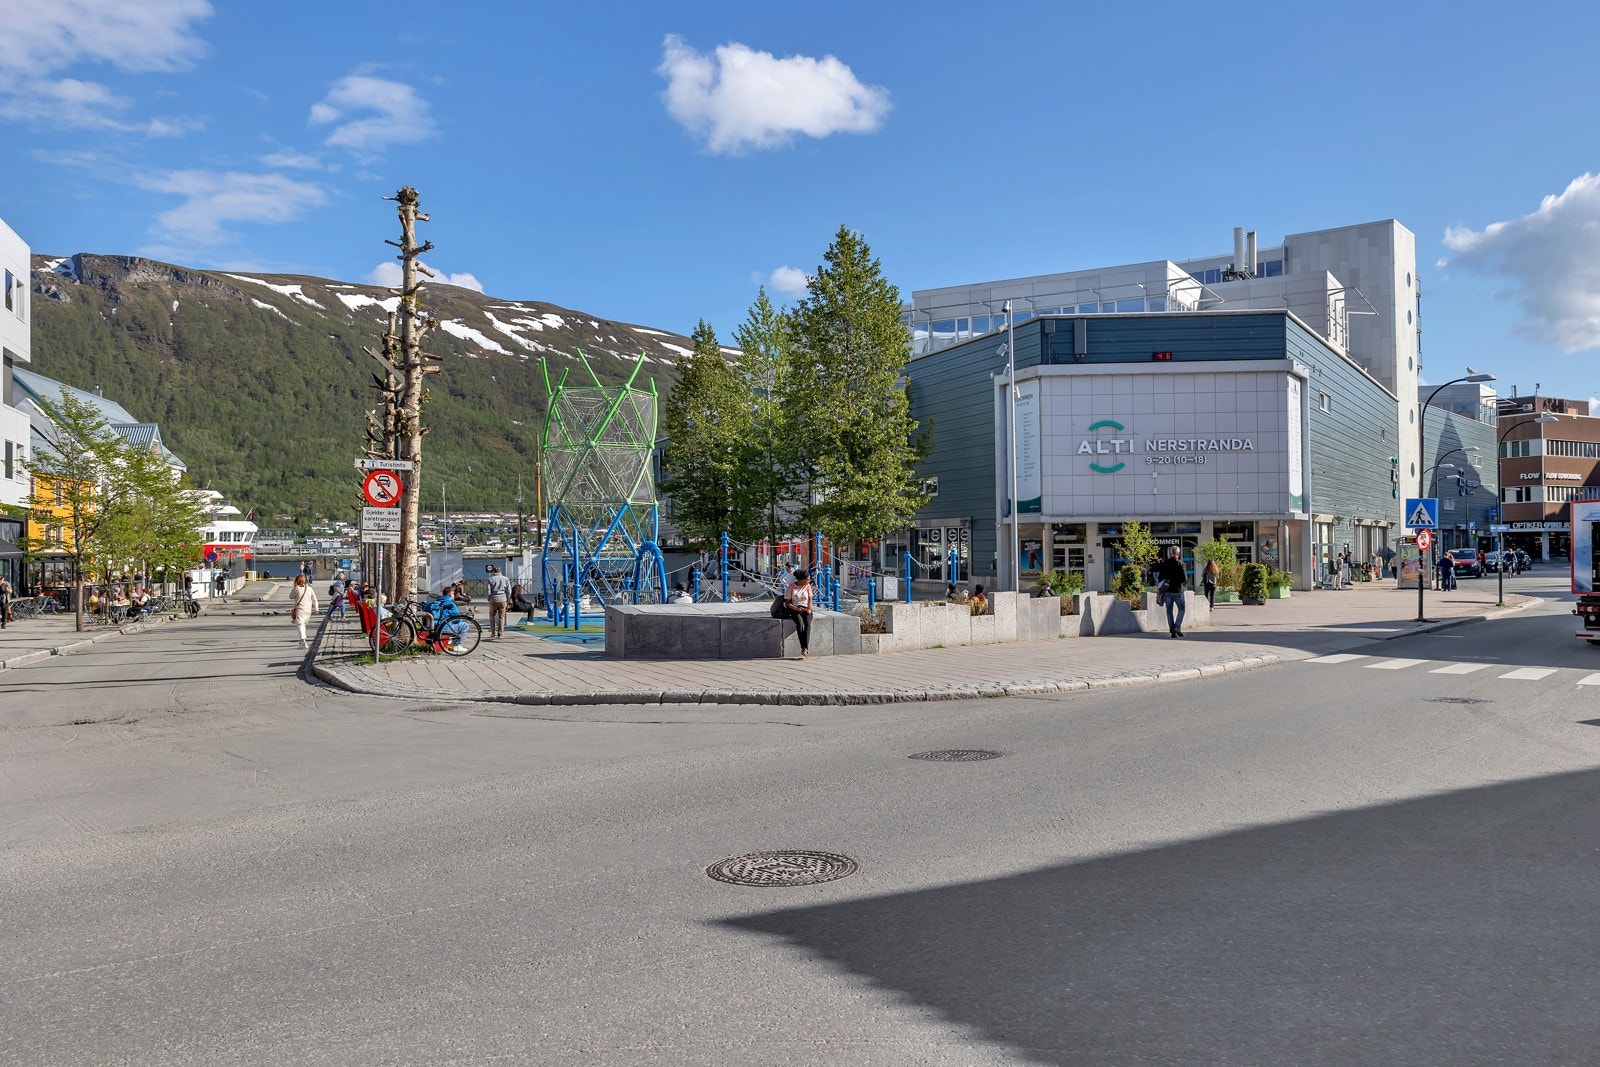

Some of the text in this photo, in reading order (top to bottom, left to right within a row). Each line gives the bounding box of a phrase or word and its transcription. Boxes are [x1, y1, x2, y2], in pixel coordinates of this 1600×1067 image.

[1077, 438, 1254, 454] ALTI NERSTRANDA
[1512, 522, 1543, 530] OPTIKER
